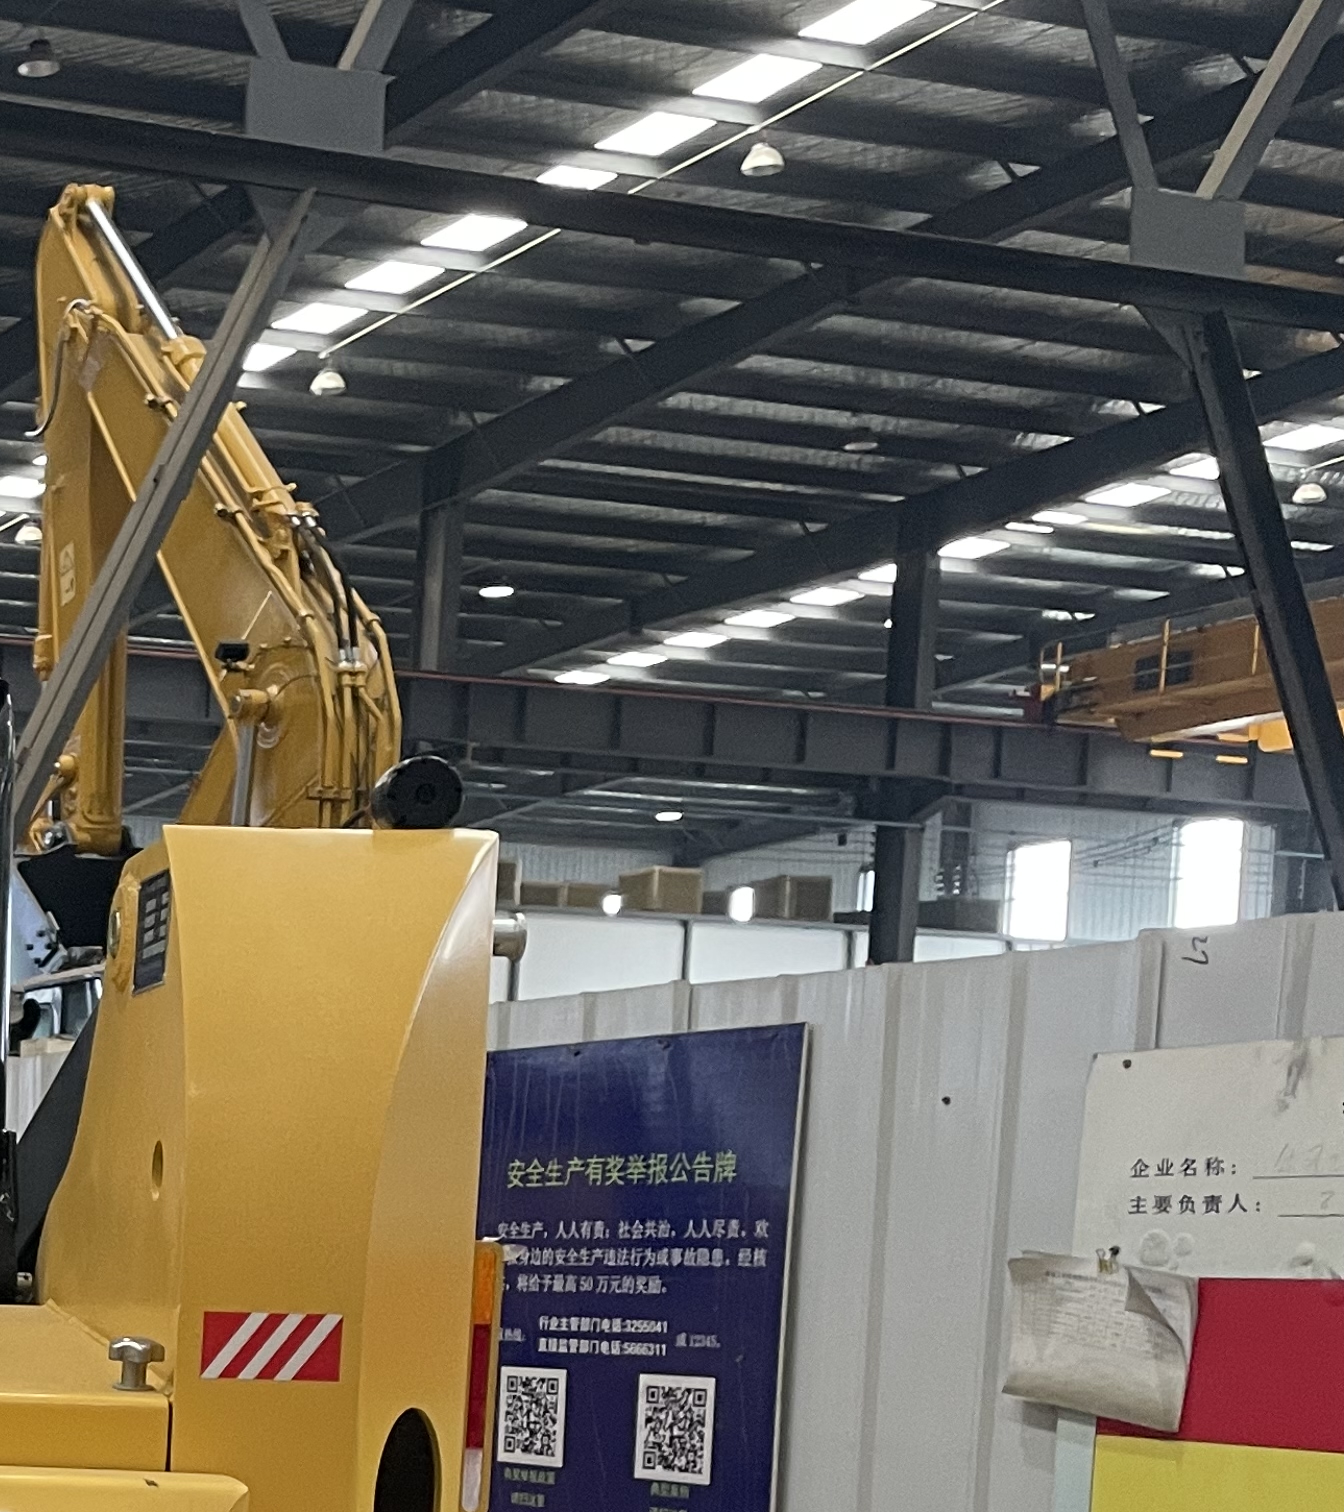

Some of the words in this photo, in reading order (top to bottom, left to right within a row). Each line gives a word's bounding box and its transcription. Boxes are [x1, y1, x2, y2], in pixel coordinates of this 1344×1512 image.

[506, 1148, 737, 1190] 安全生产有奖举报公告牌
[1130, 1156, 1236, 1178] 企业名称：
[1128, 1193, 1261, 1215] 主要负责人：
